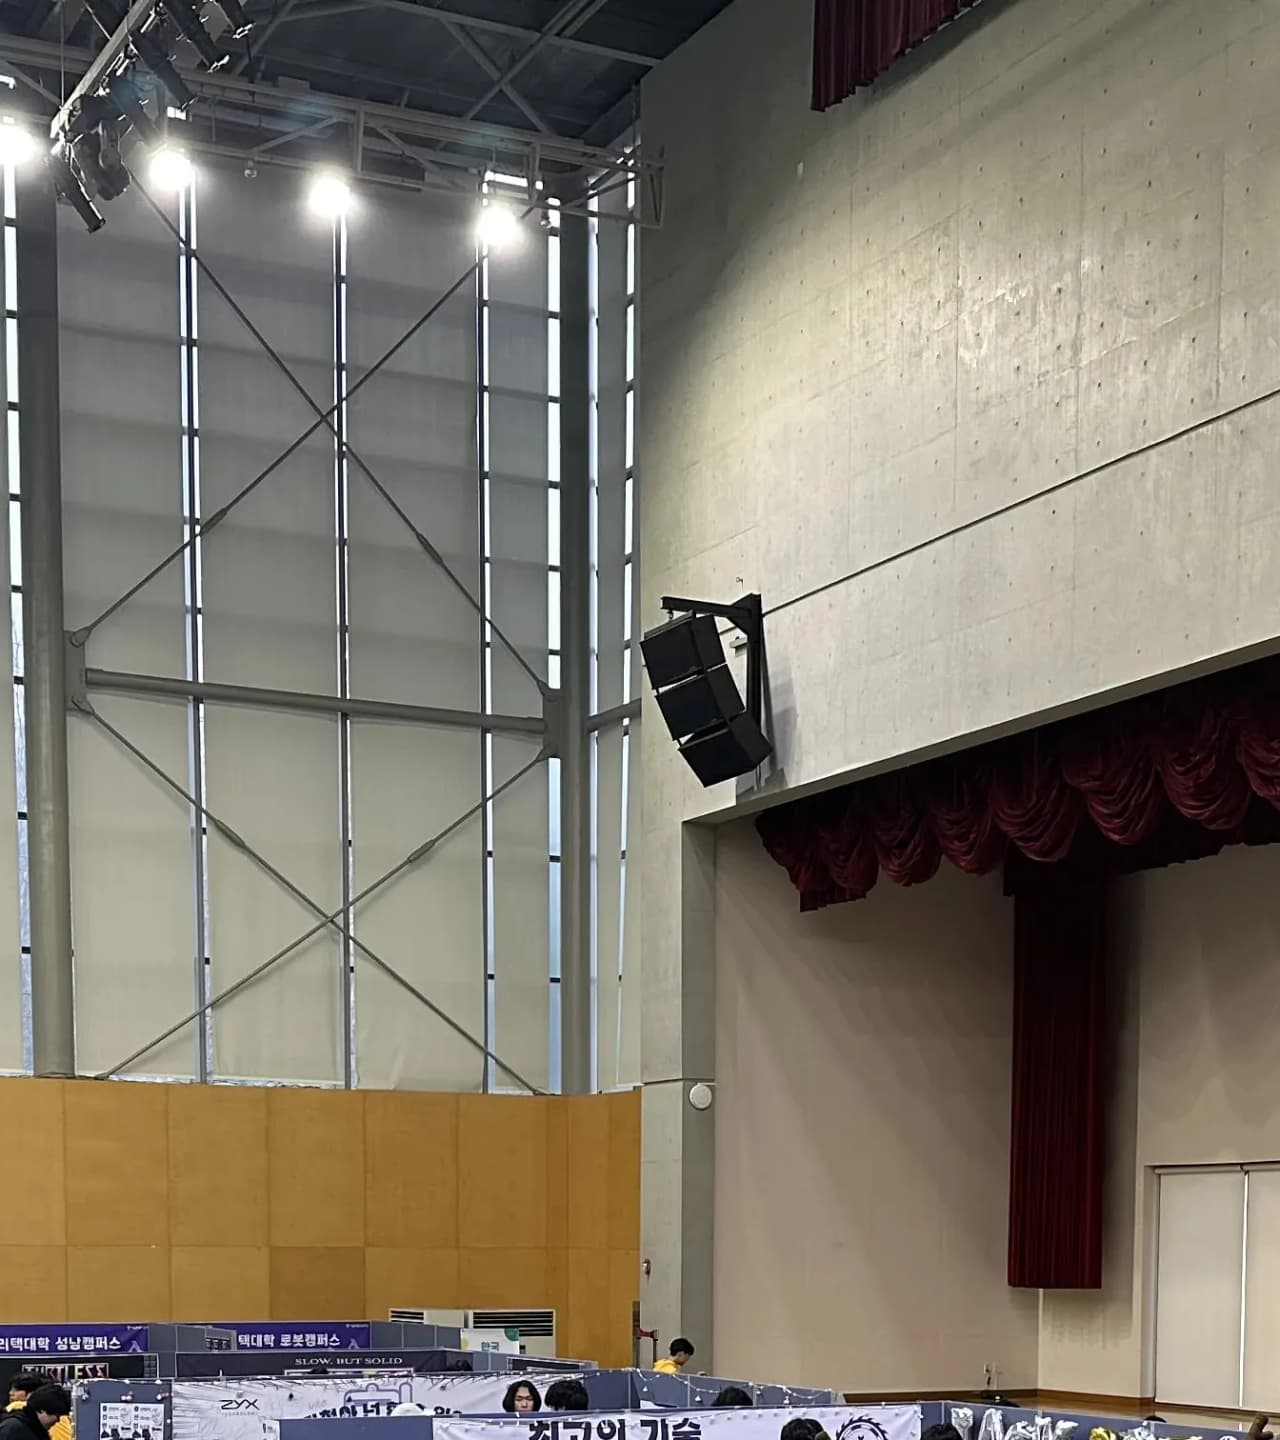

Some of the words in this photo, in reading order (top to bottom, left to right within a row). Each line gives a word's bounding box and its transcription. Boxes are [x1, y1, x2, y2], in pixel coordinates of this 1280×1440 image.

[55, 1336, 121, 1351] 성남캠퍼스
[279, 1333, 341, 1348] 로봇캠퍼스
[336, 1357, 361, 1365] BUT
[365, 1357, 403, 1365] SOLID
[220, 1398, 260, 1411] ZYX
